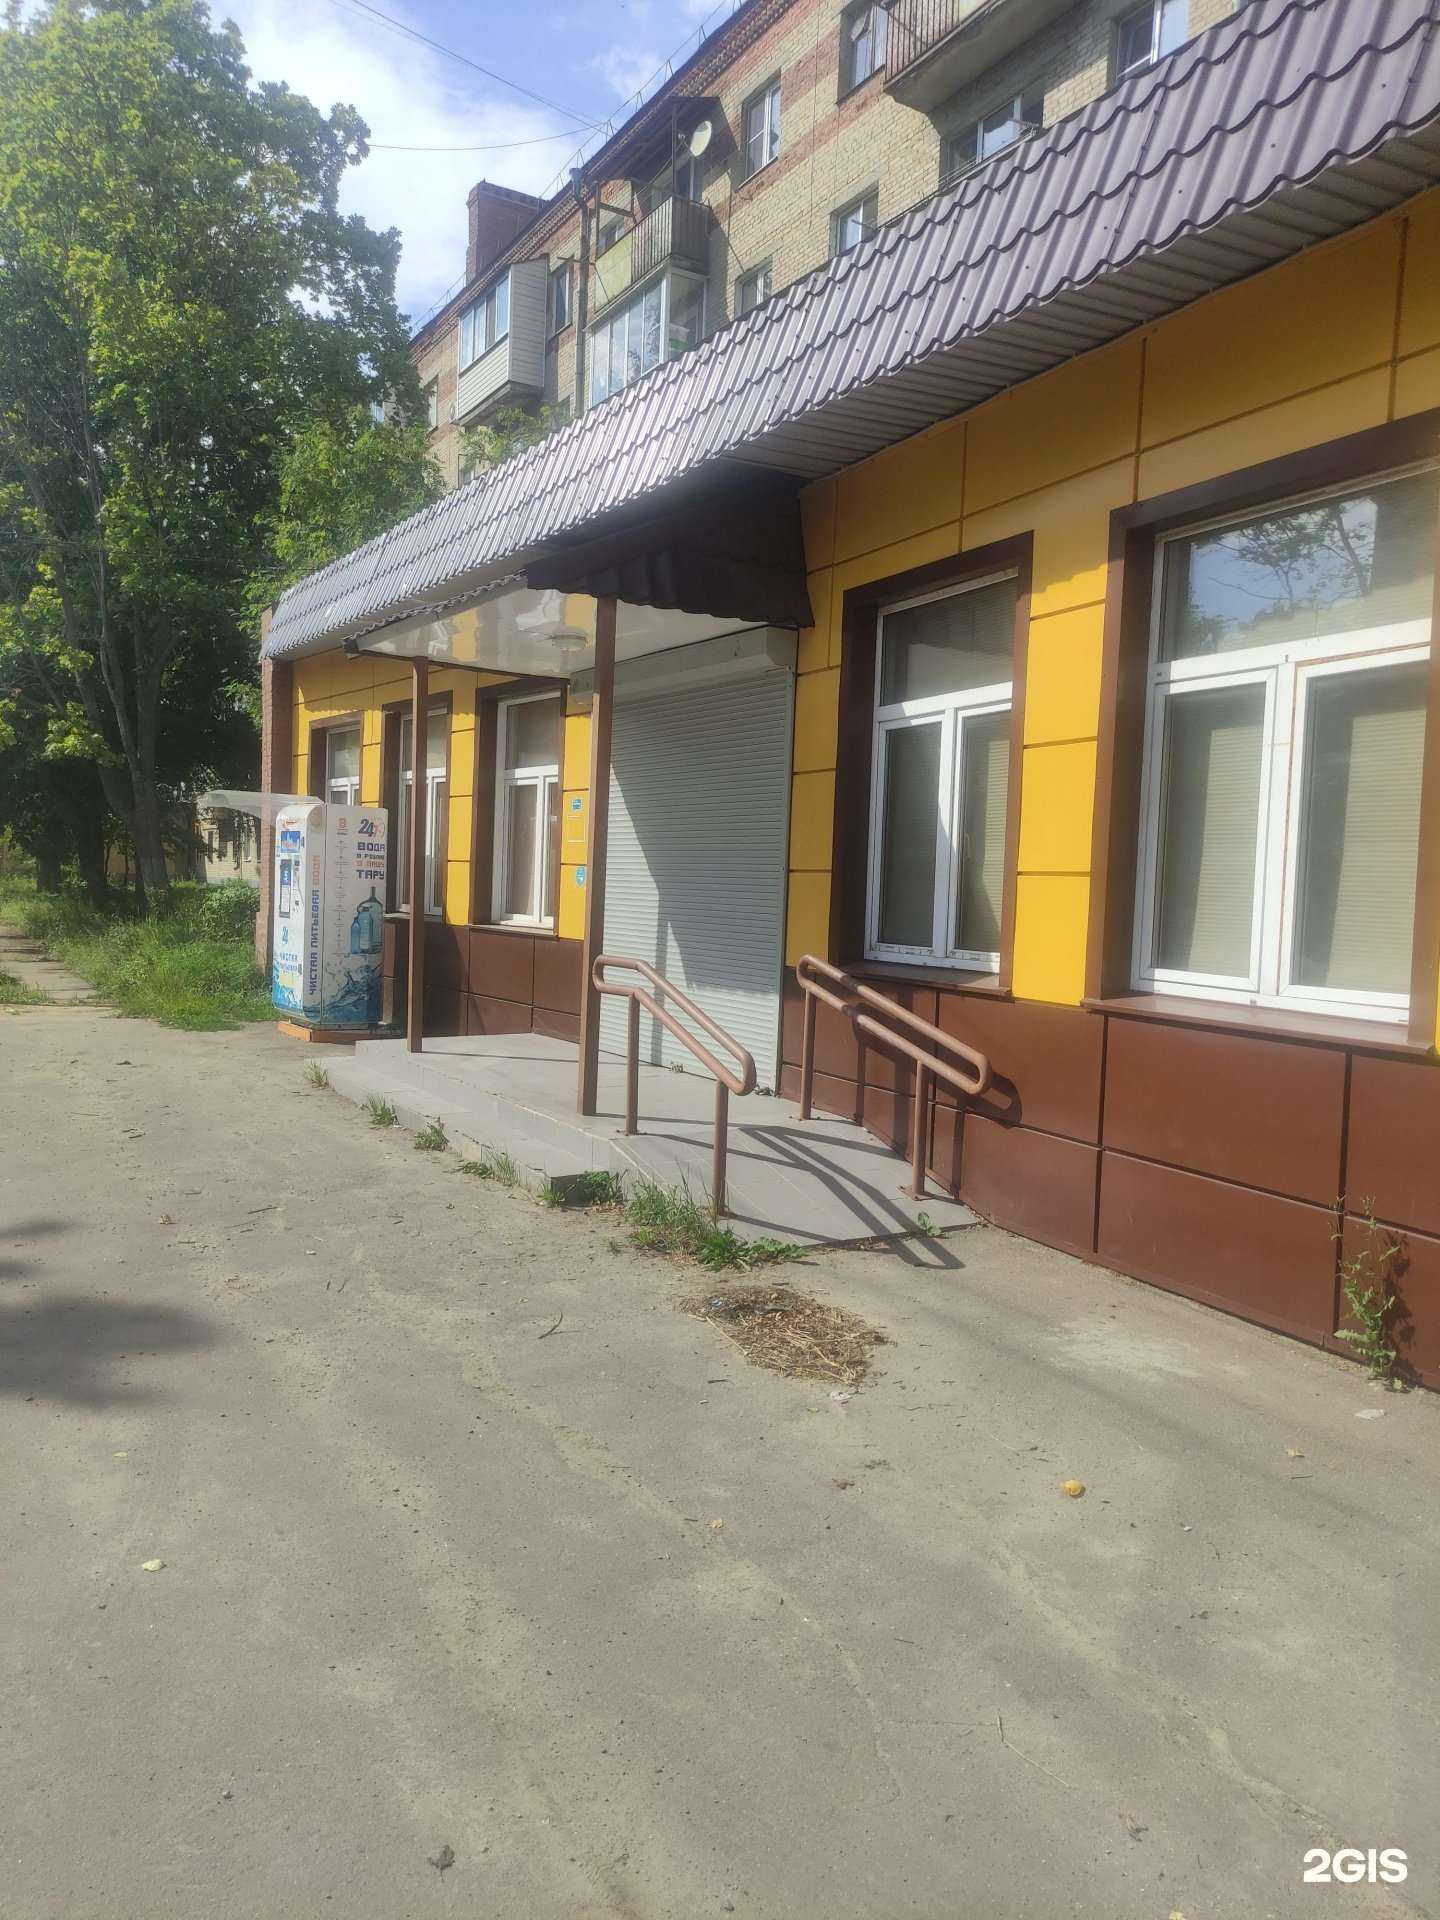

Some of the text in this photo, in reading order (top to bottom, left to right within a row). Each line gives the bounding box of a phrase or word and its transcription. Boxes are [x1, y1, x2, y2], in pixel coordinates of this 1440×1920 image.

[357, 842, 386, 852] ВОДА
[356, 869, 385, 880] ТАРУ
[310, 889, 320, 948] ПИТЬЕВАЯ
[309, 952, 318, 996] ЧИСТАЯ
